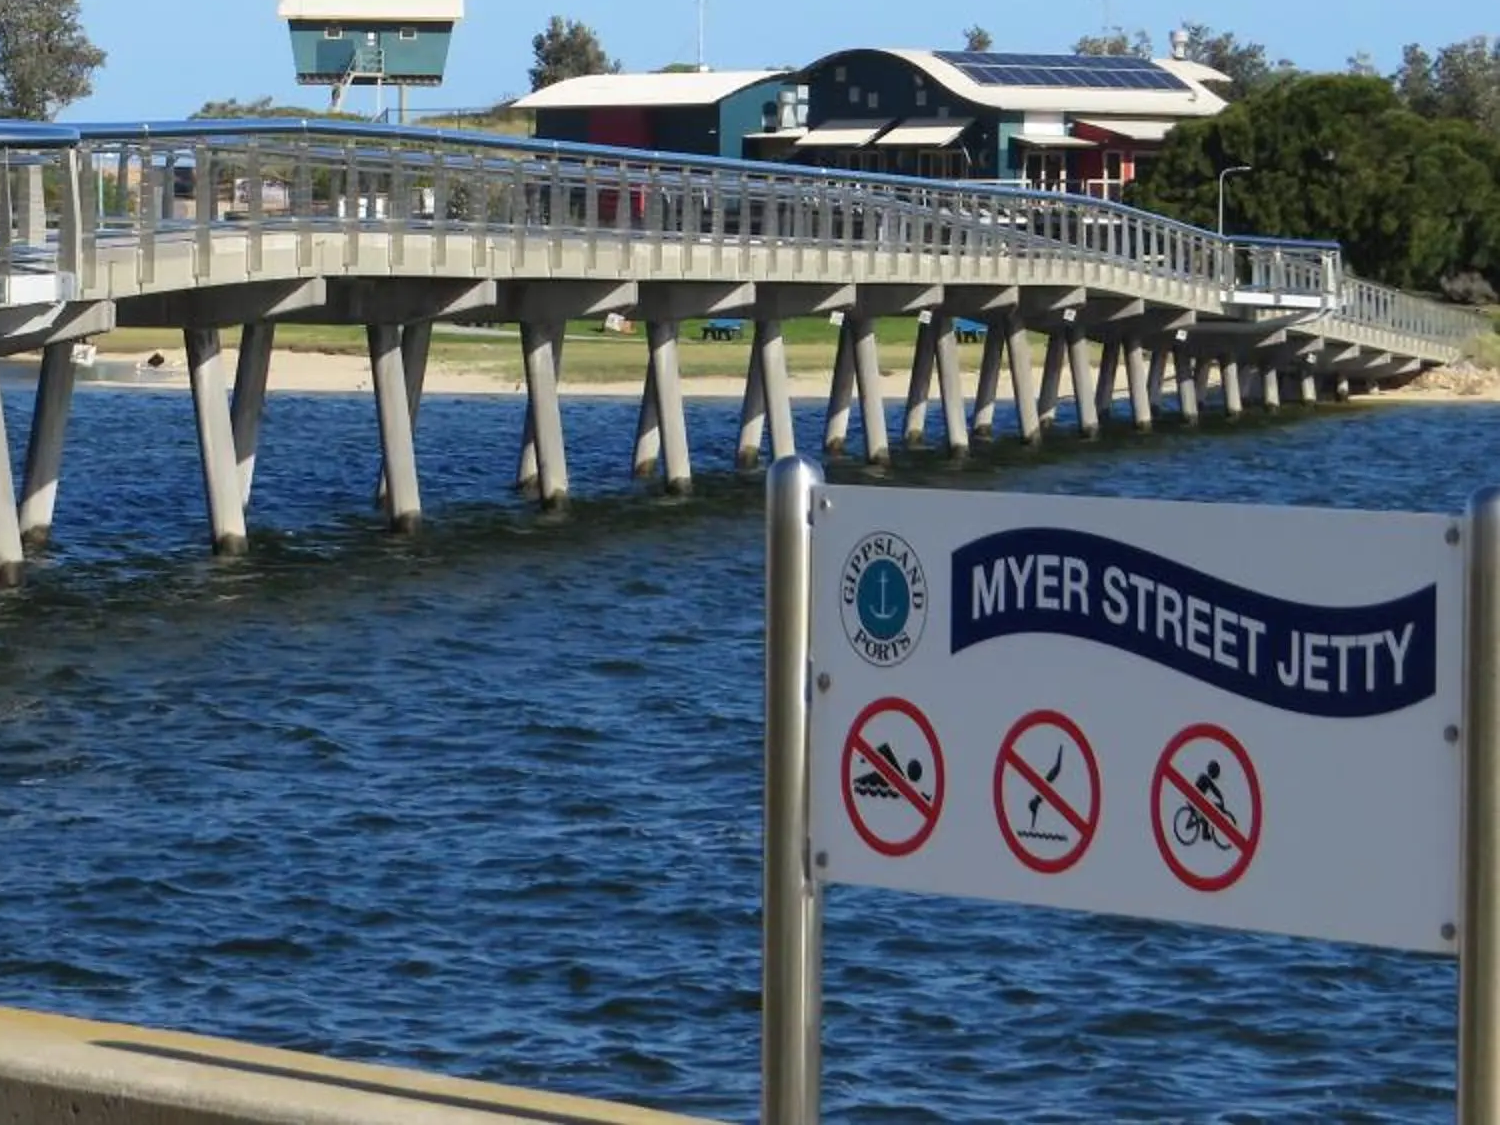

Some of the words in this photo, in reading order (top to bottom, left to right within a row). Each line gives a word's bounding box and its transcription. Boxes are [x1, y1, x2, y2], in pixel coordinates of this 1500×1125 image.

[844, 538, 925, 609] GIPPSLAND
[854, 629, 911, 661] PORTS
[971, 553, 1090, 621] MYER
[1102, 566, 1267, 676] STREET
[1277, 622, 1415, 693] JETTY
